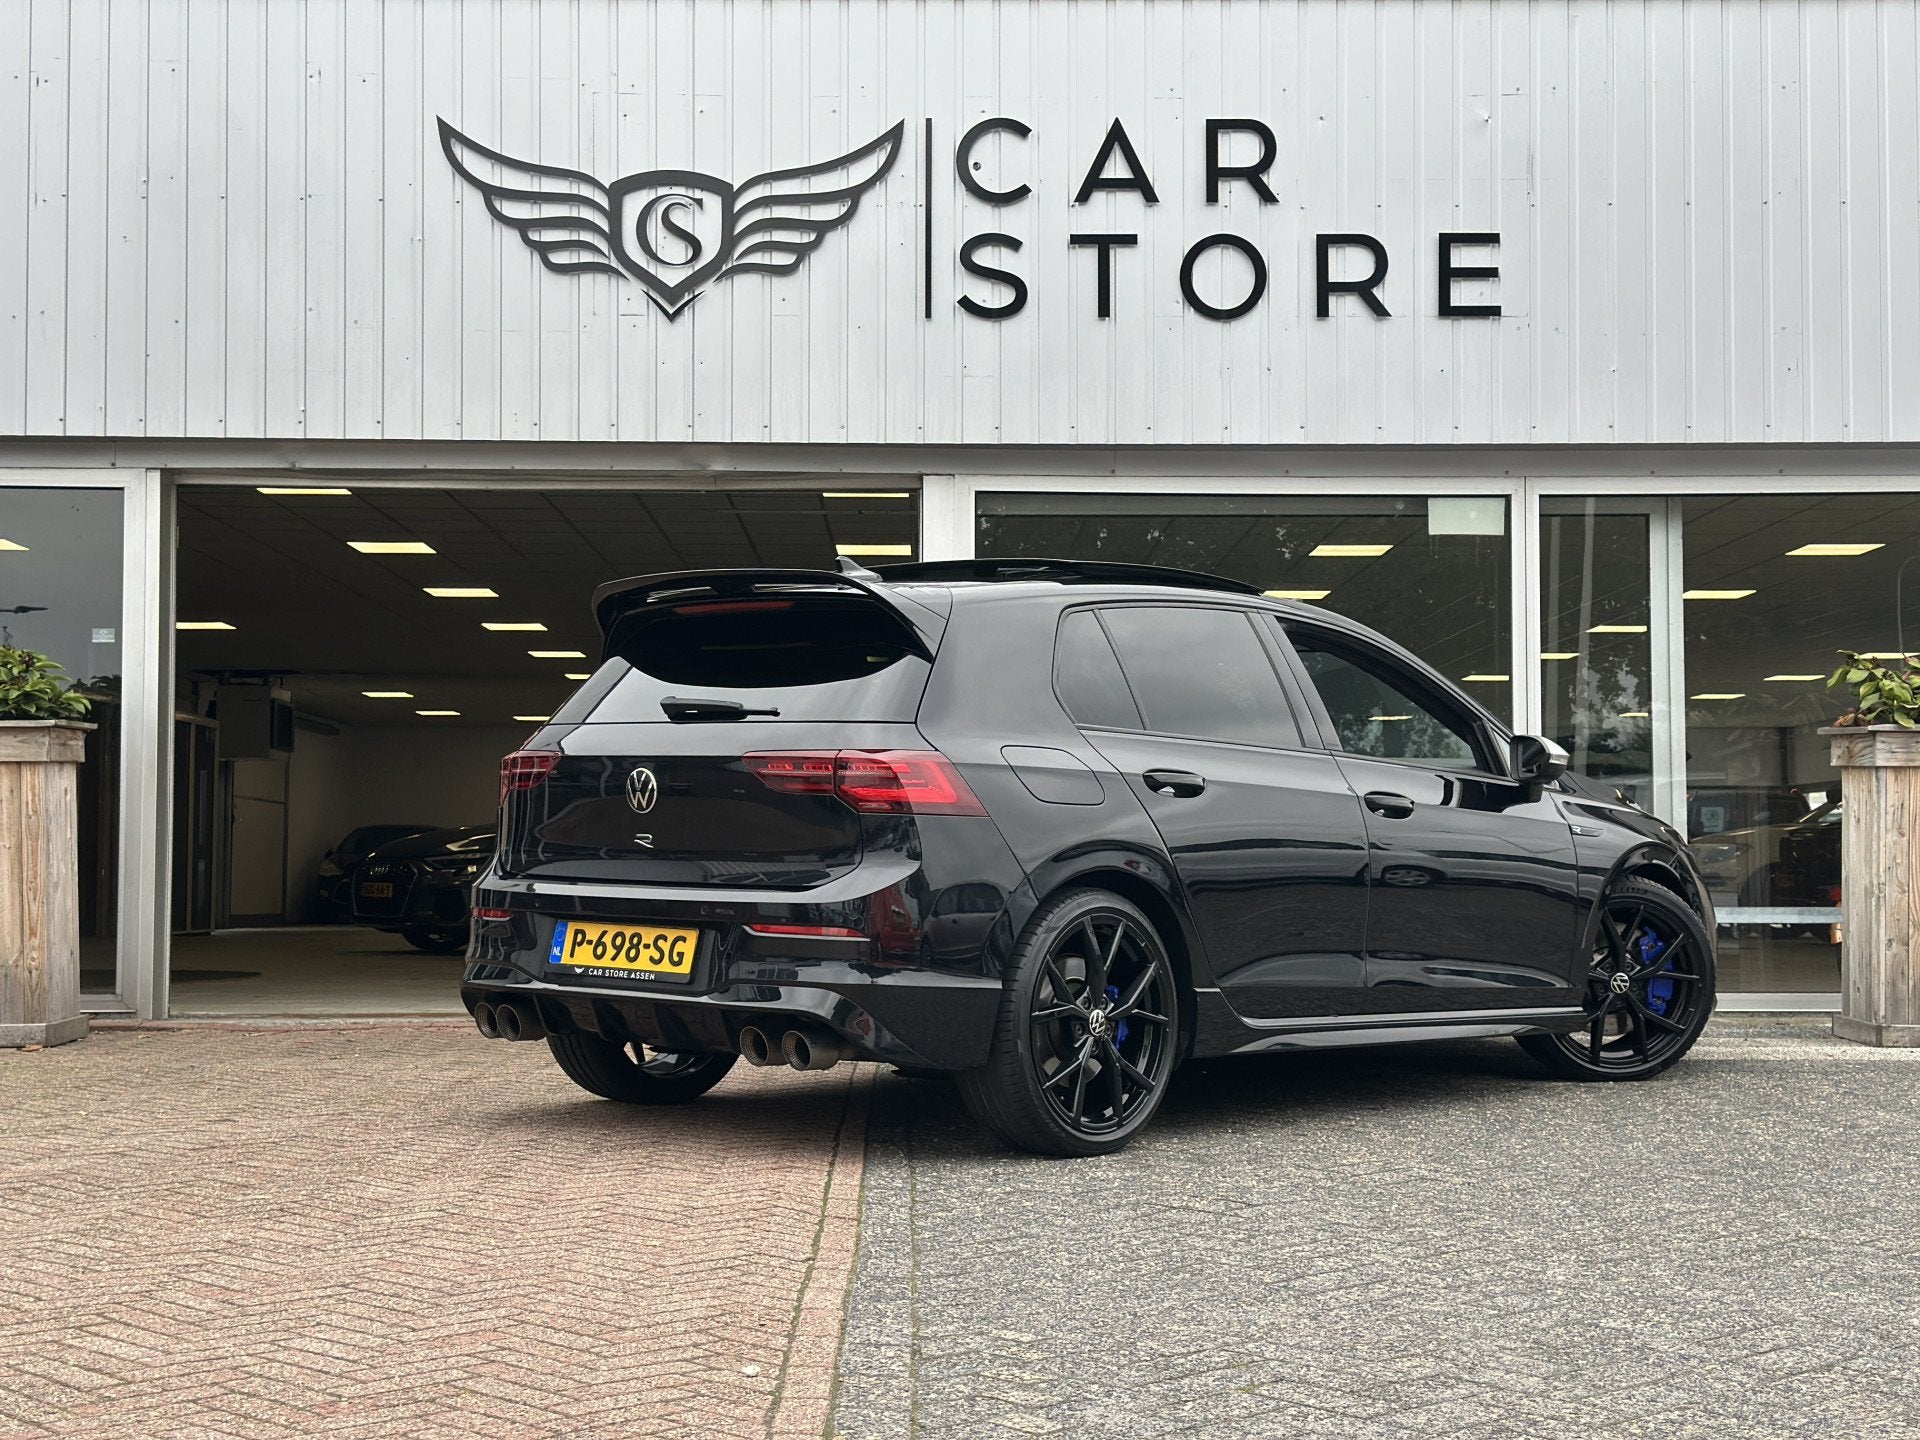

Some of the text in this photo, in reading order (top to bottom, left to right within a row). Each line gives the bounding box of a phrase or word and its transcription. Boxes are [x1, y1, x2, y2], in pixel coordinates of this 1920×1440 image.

[956, 118, 1279, 207] CAR
[636, 193, 704, 267] CS
[957, 233, 1502, 321] STORE
[626, 767, 657, 813] VW
[634, 833, 655, 848] R
[552, 946, 562, 956] NL
[569, 928, 687, 967] P-698-SG
[588, 967, 656, 980] CAR STORE ASSEN
